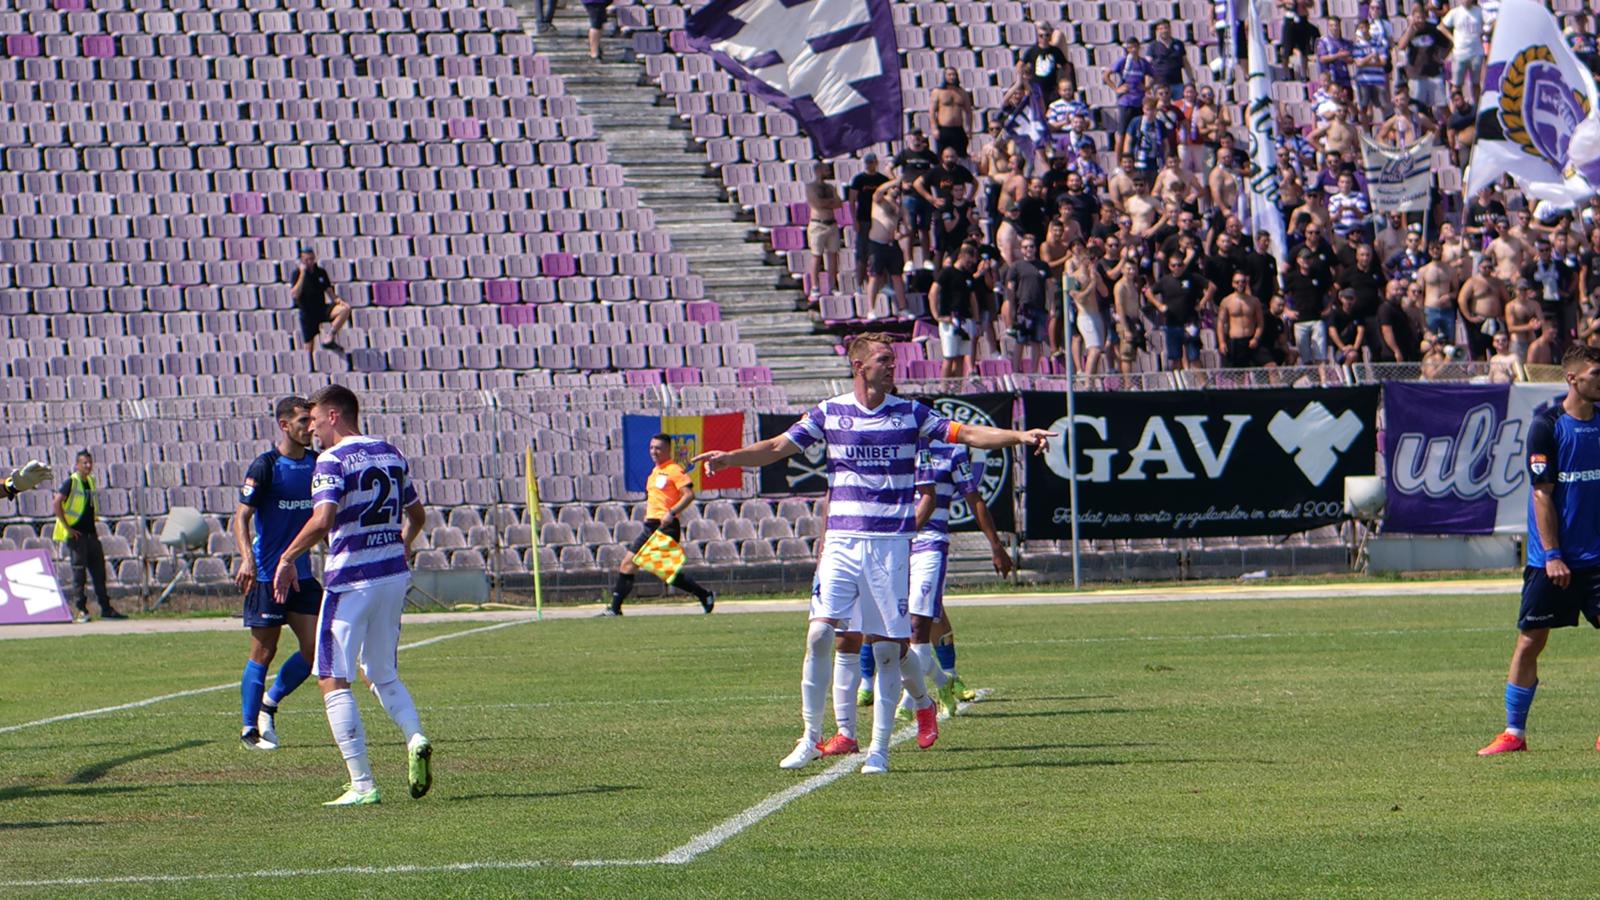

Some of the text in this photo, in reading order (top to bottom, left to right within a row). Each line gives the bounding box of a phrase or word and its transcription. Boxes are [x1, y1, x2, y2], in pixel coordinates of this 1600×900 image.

[845, 446, 900, 459] UNIBET
[1044, 414, 1252, 482] GAV
[359, 465, 404, 527] 21
[1052, 507, 1102, 524] Fodat
